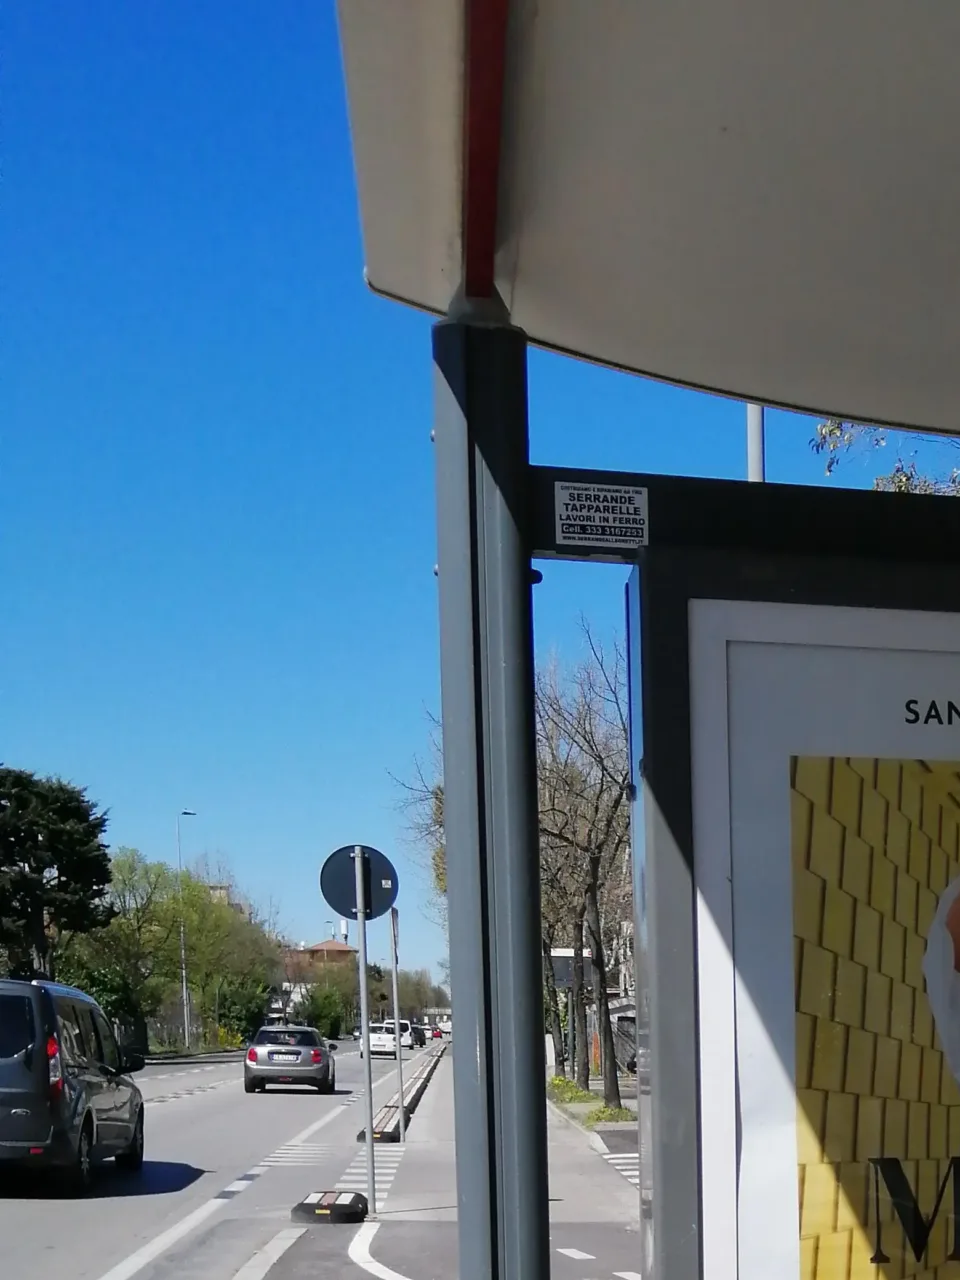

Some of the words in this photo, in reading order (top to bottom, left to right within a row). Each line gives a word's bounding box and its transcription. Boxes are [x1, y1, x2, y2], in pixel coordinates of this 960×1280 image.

[568, 492, 635, 504] SERRANDE
[563, 502, 641, 516] TAPPARELLE
[559, 514, 596, 523] LAVORI
[599, 515, 609, 524] IN
[612, 516, 645, 525] FERRO
